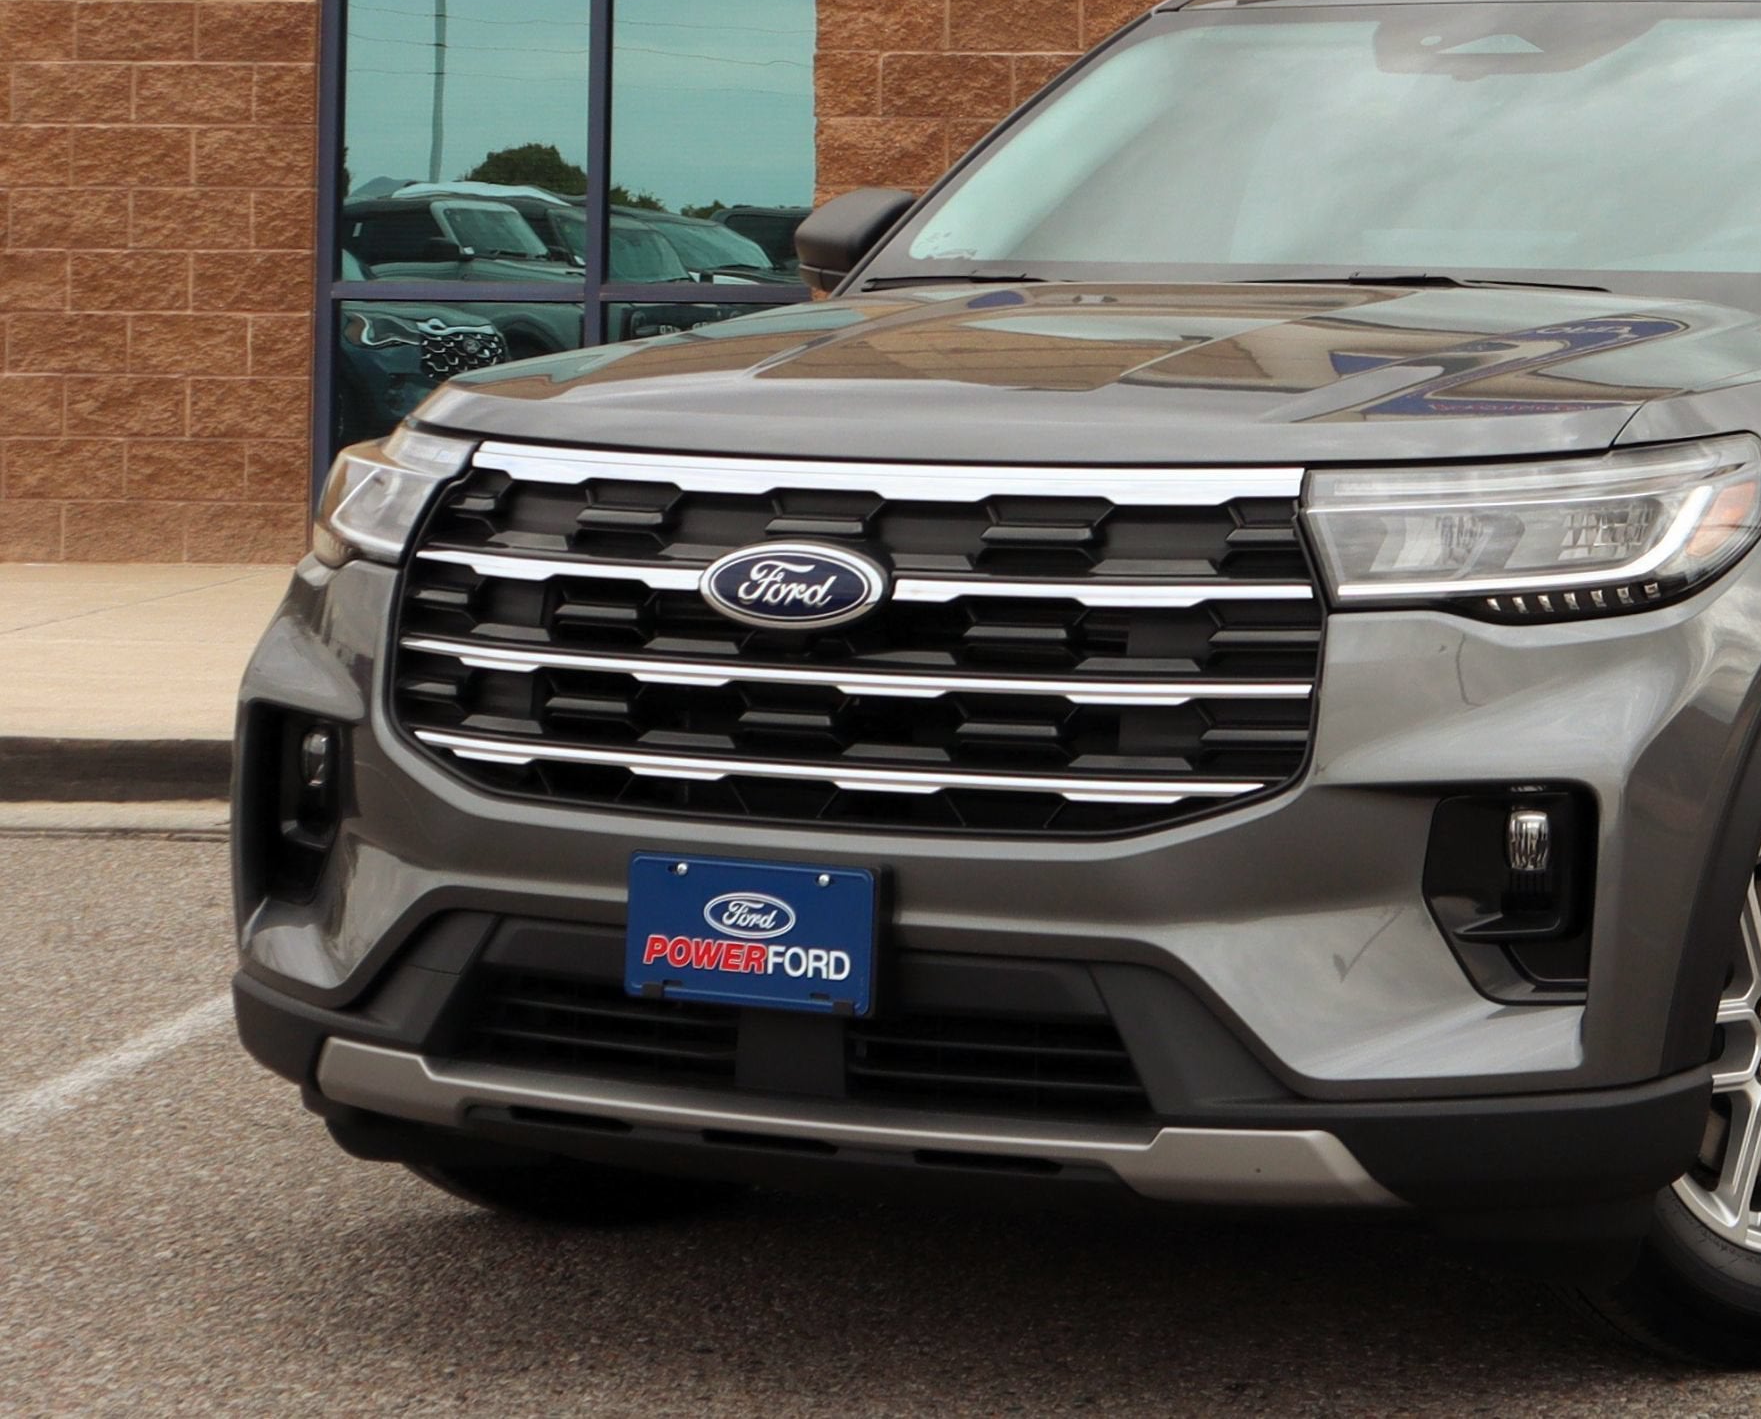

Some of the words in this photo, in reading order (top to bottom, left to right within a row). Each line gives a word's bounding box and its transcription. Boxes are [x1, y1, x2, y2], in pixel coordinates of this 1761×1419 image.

[737, 560, 838, 606] Ford
[722, 899, 777, 930] Ford
[643, 935, 851, 981] POWERFORD
